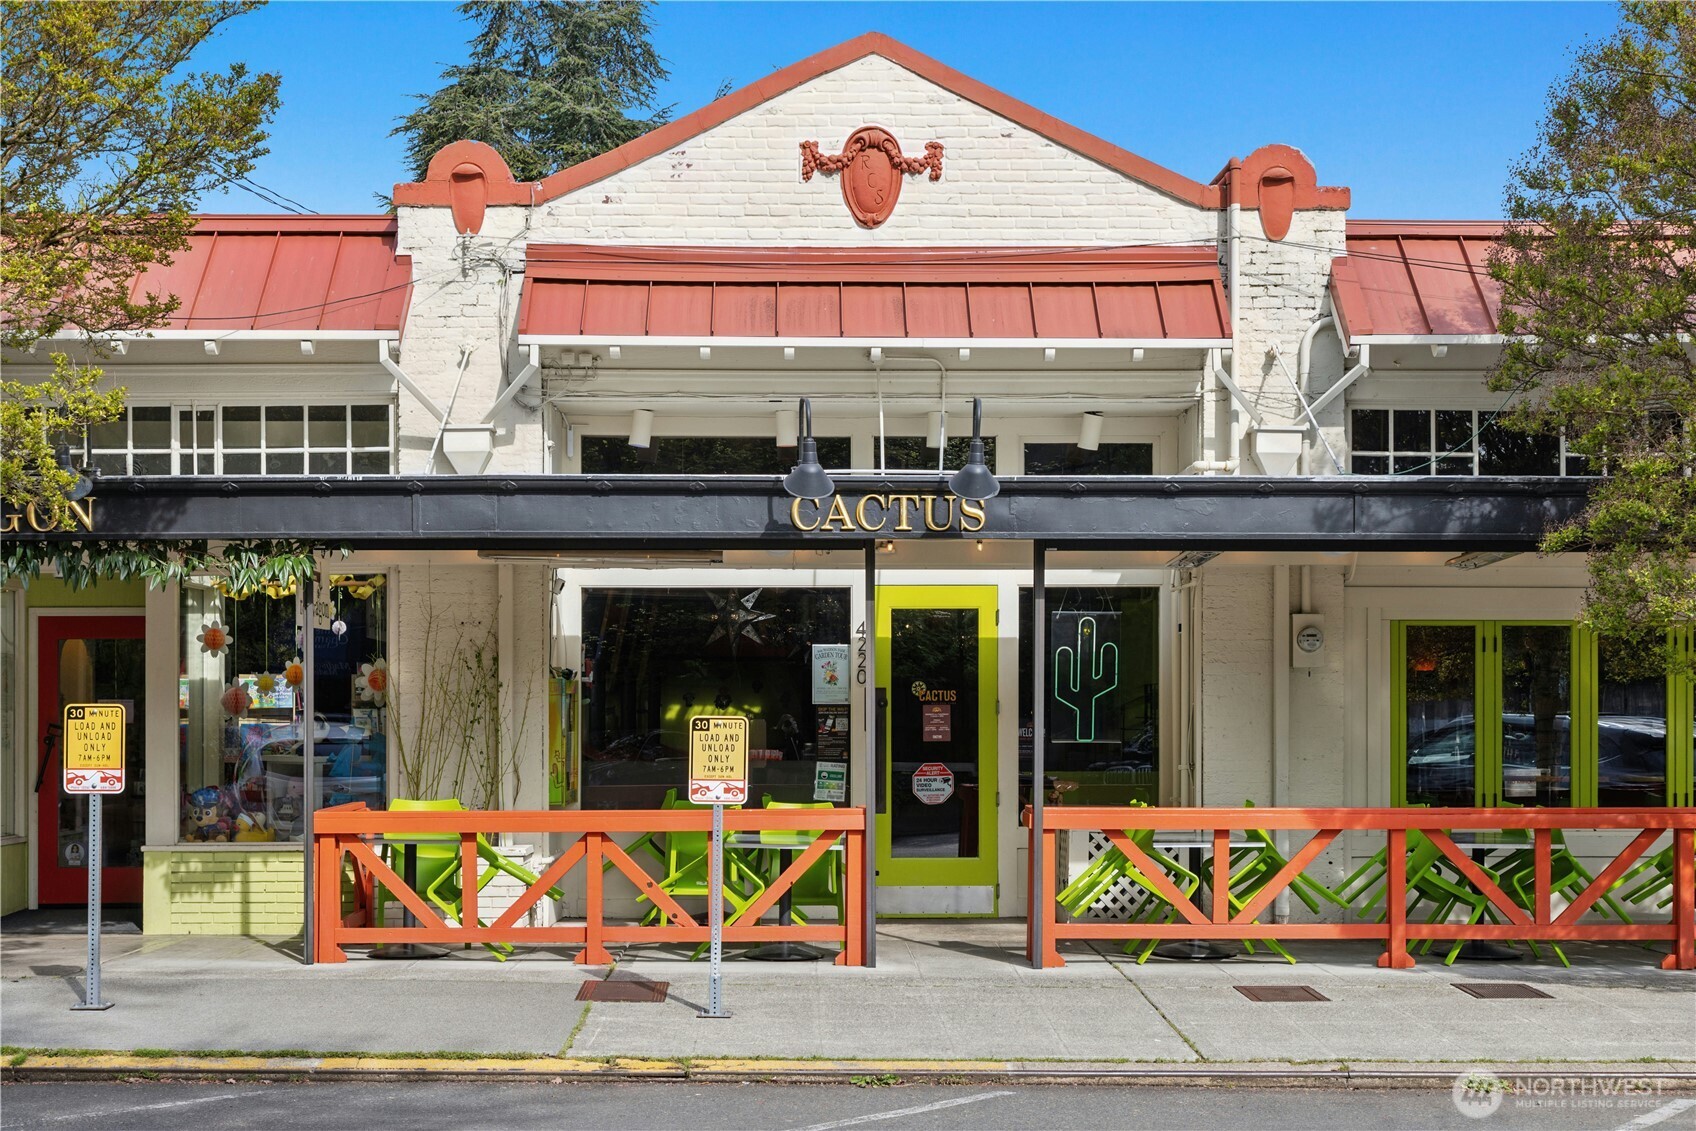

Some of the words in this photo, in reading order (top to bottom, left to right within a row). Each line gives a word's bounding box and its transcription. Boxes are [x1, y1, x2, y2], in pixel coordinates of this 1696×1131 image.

[790, 494, 986, 532] CACTUS
[815, 652, 834, 660] GARDEN
[835, 652, 848, 660] TOUR
[856, 621, 866, 684] 4220
[919, 690, 957, 701] CACTUS
[70, 709, 83, 718] 30
[75, 722, 95, 730] LOAD
[101, 722, 116, 730] AND
[695, 720, 708, 729] 30
[77, 732, 112, 740] UNLOAD
[700, 733, 720, 742] LOAD
[724, 733, 739, 742] AND
[84, 743, 106, 752] ONLY
[702, 744, 735, 752] UNLOAD
[708, 755, 730, 763] ONLY
